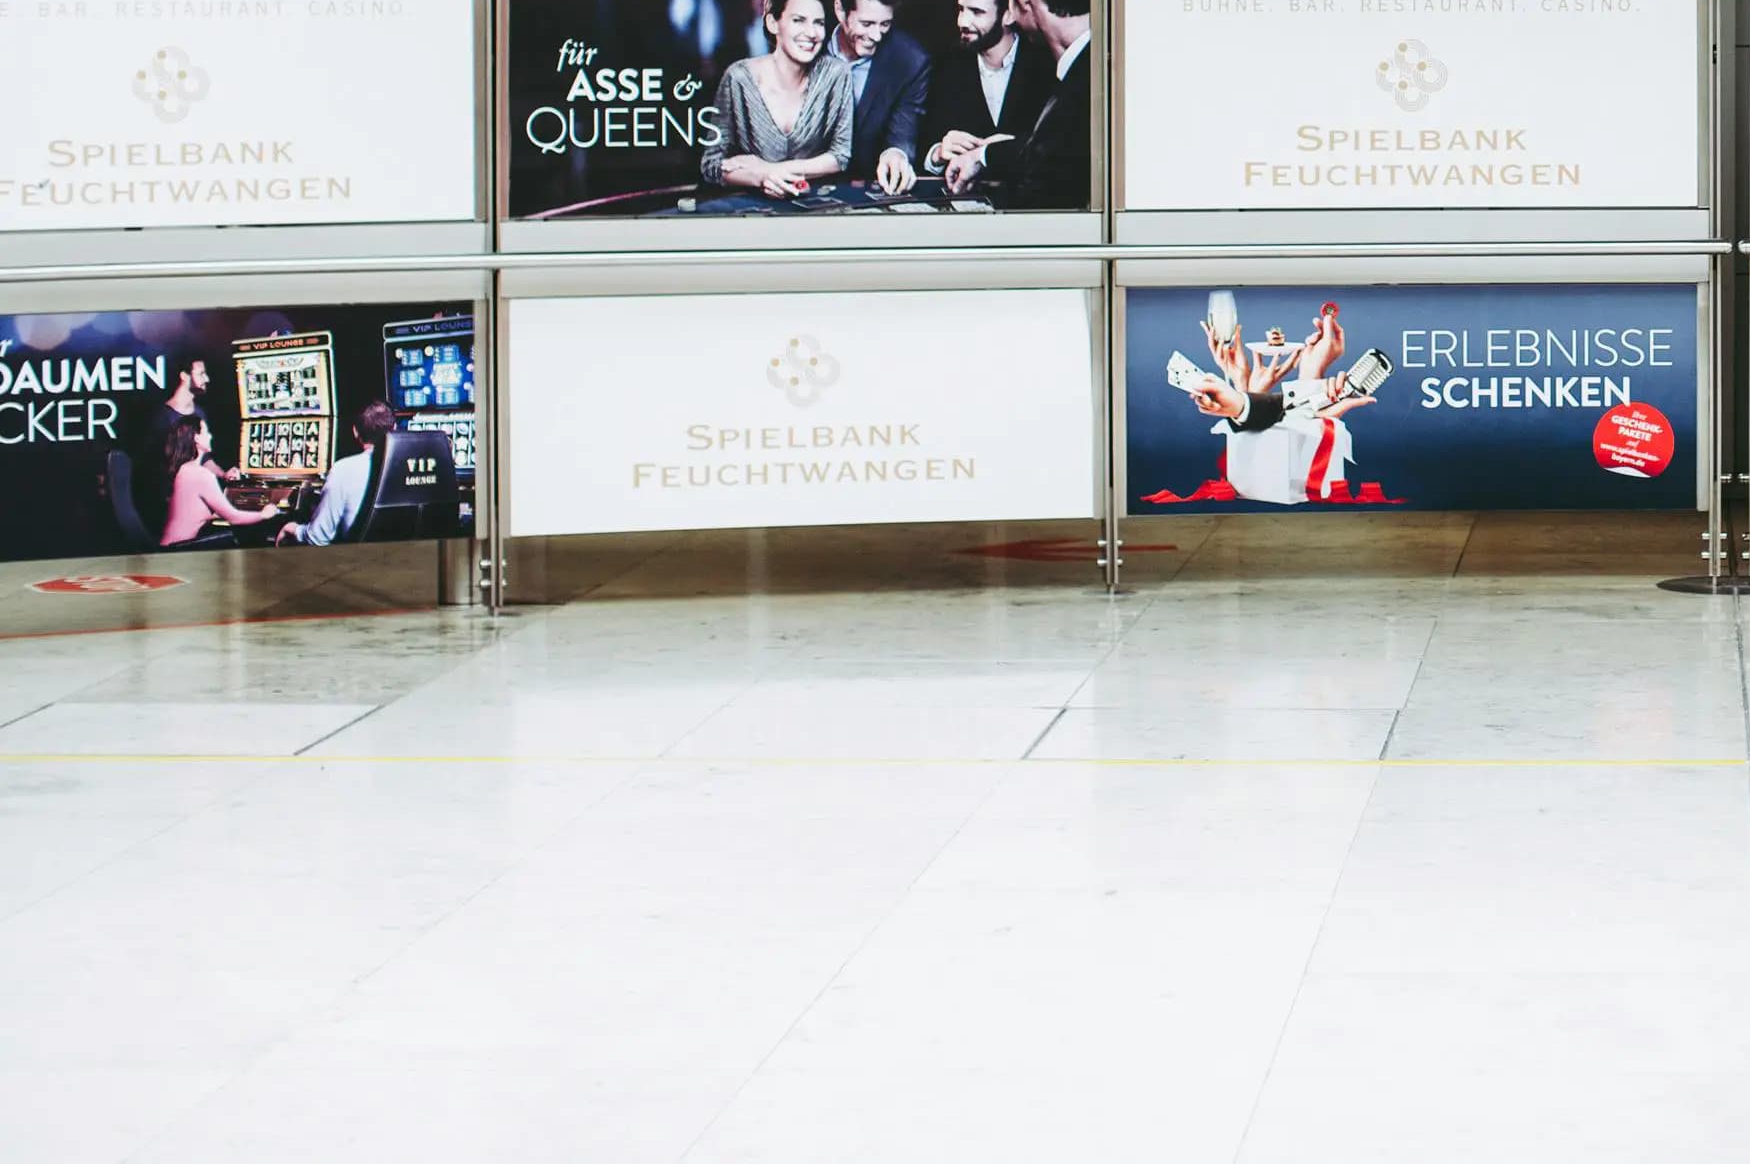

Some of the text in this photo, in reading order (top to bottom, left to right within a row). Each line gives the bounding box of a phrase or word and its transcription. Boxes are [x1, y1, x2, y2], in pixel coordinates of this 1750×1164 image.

[558, 38, 598, 72] für
[568, 68, 702, 102] ASSE &
[526, 108, 722, 154] QUEENS
[1296, 125, 1527, 152] SPIELBANK
[48, 140, 295, 168] SPIELBANK
[1244, 162, 1582, 187] FEUCHTWANGEN
[1401, 328, 1673, 368] ERLEBNISSE
[1421, 376, 1631, 408] SCHENKEN
[686, 423, 921, 452] SPIELBANK
[1618, 427, 1652, 441] PAKETE
[406, 458, 436, 472] VIP
[632, 458, 976, 489] FEUCHTWANGEN
